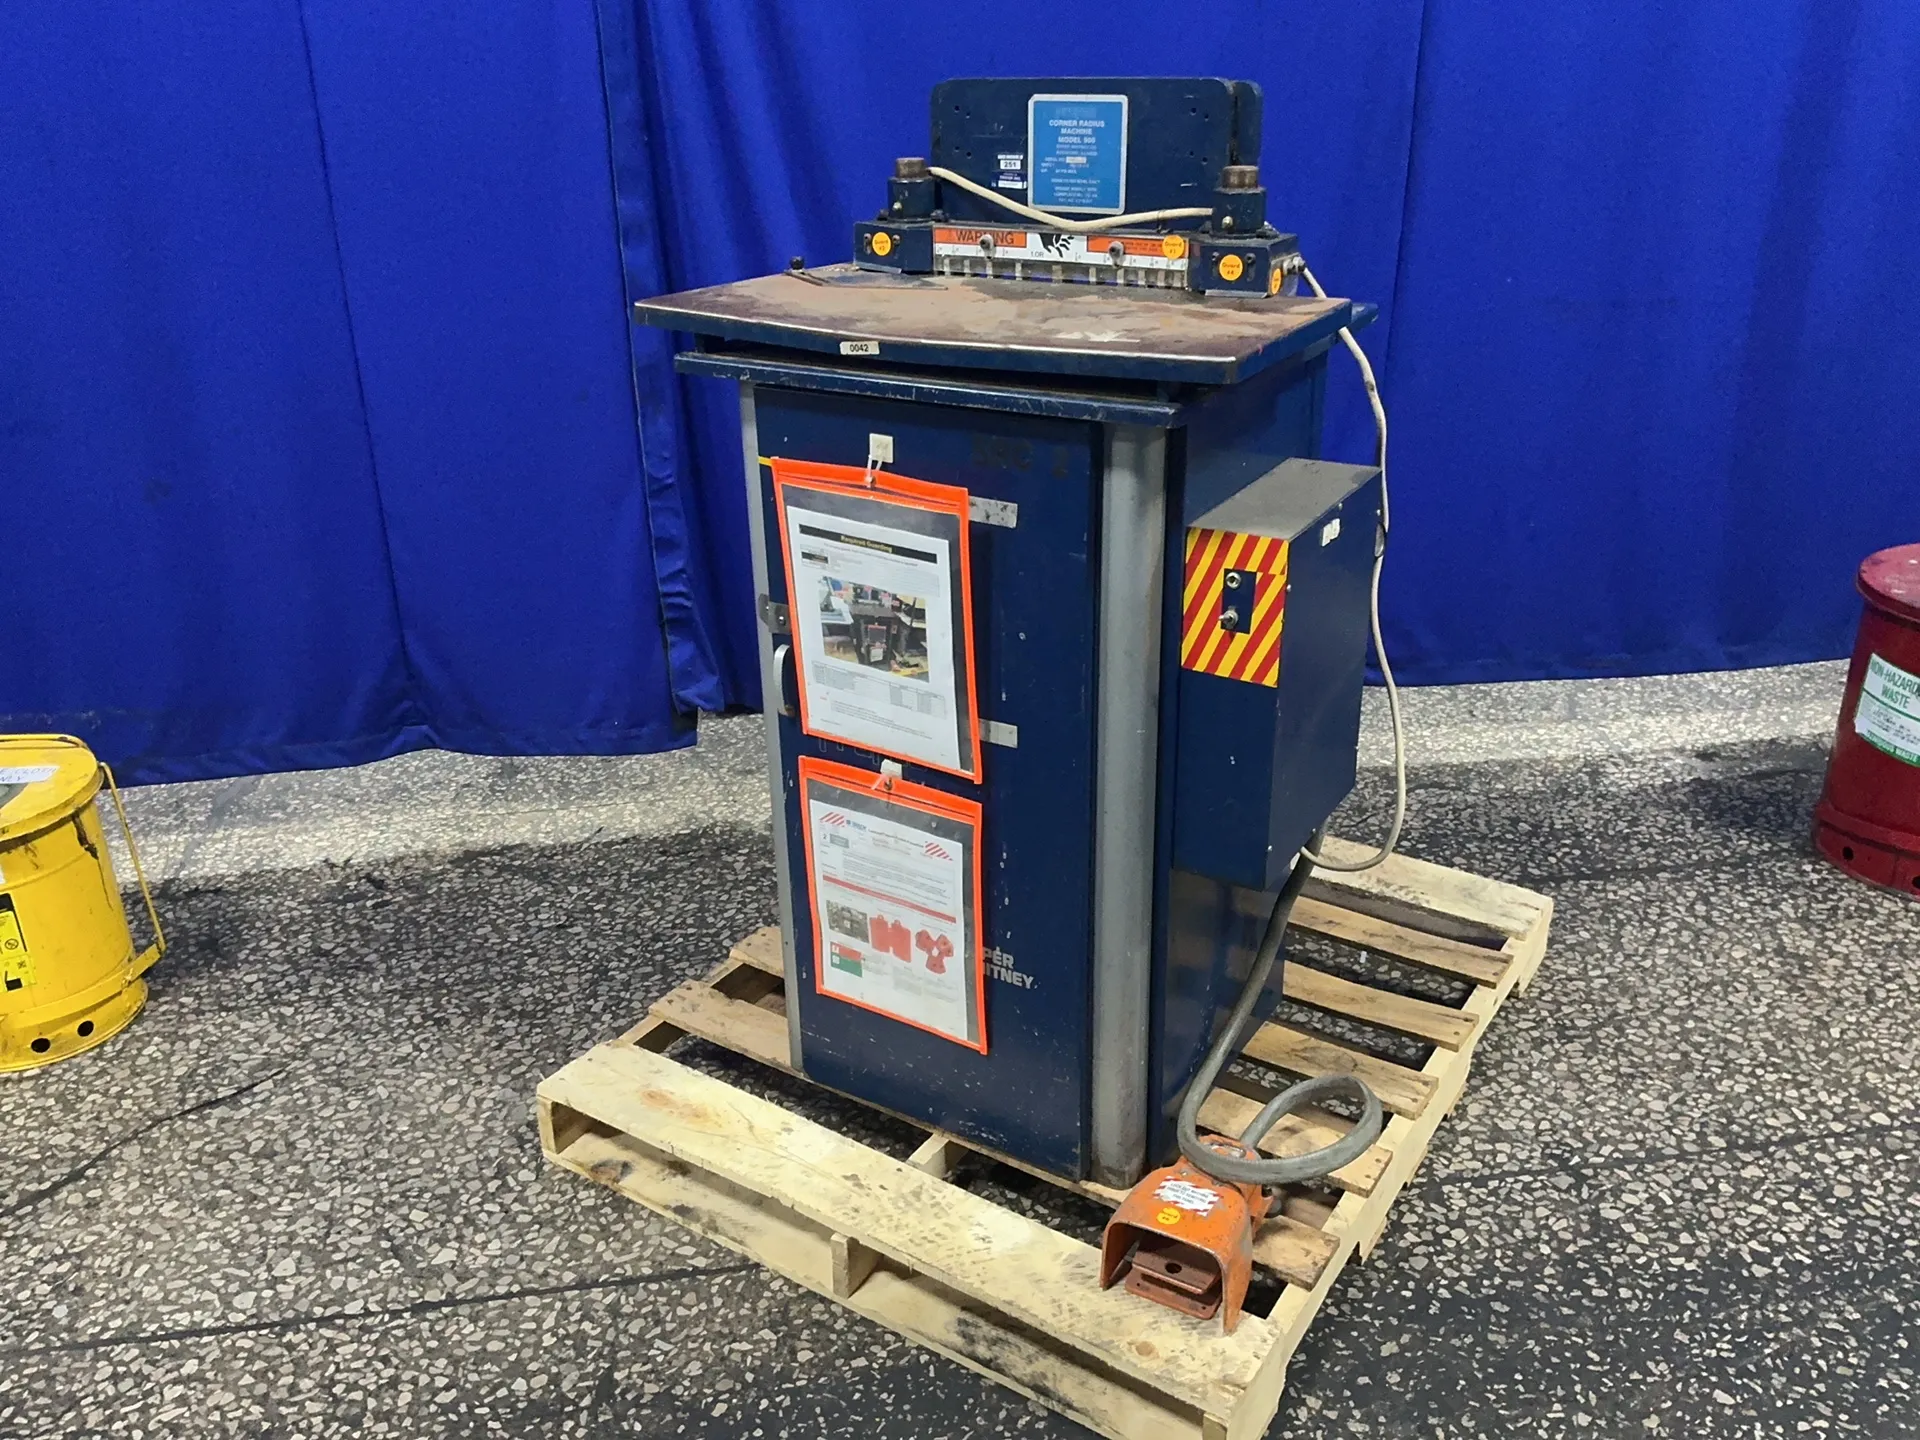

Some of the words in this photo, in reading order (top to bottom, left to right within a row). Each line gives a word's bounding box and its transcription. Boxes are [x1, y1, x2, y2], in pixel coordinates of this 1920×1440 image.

[1049, 119, 1077, 127] CORNER
[1078, 120, 1105, 128] RADIUS
[956, 229, 1014, 245] WARING
[849, 344, 869, 352] 0042
[866, 541, 893, 554] Guarding
[1881, 684, 1911, 709] WASTE
